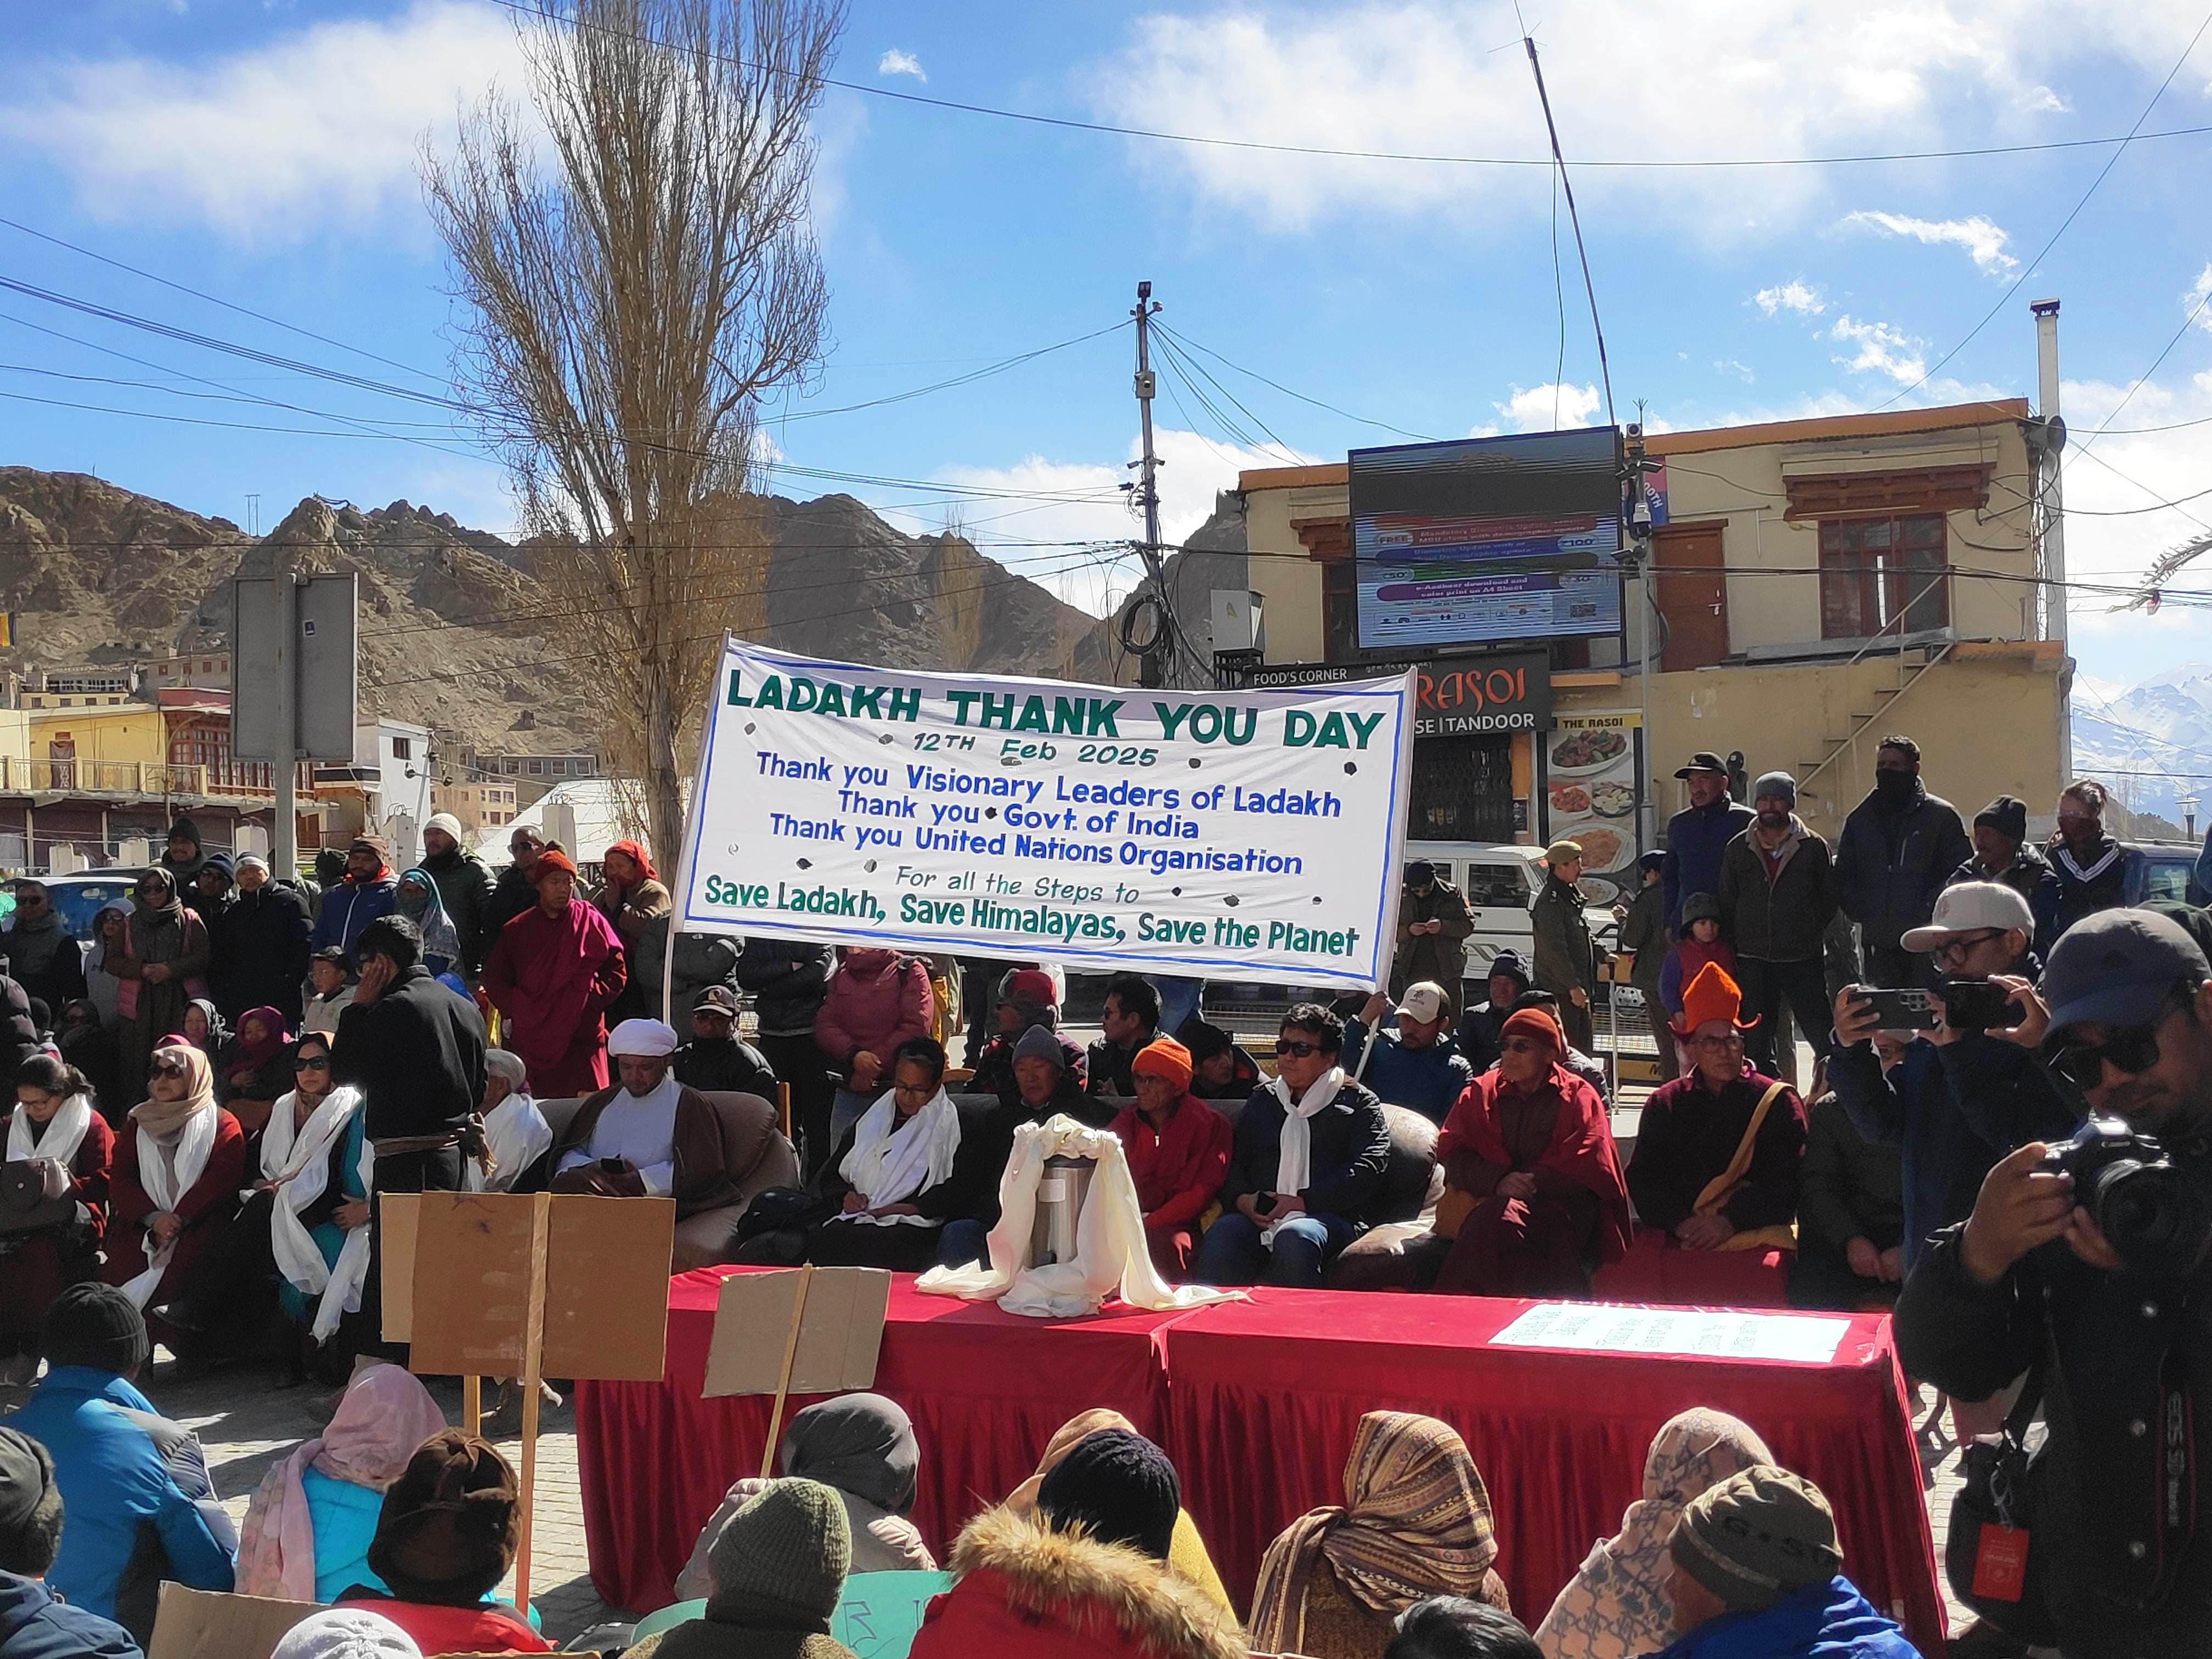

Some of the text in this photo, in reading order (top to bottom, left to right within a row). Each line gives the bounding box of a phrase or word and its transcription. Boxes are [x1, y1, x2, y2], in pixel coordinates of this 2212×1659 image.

[1253, 668, 1348, 686] FOOD'S CORNER
[726, 668, 1387, 750] LADAKH THANK YOU DAY
[1414, 713, 1536, 735] SE TANDOOR
[1562, 718, 1624, 729] THE RASOI
[913, 732, 1159, 767] 12TH Feb 2025
[756, 751, 1341, 818] Thank you Visionary Leaders of Ladakh
[838, 790, 1200, 839] Thank you Govt. of India
[770, 812, 1302, 875] Thank you United Nations Organisation
[894, 866, 1141, 906] For all the Steps to
[704, 874, 1361, 957] Save Ladakh, Save Himalayas, Save the Planet
